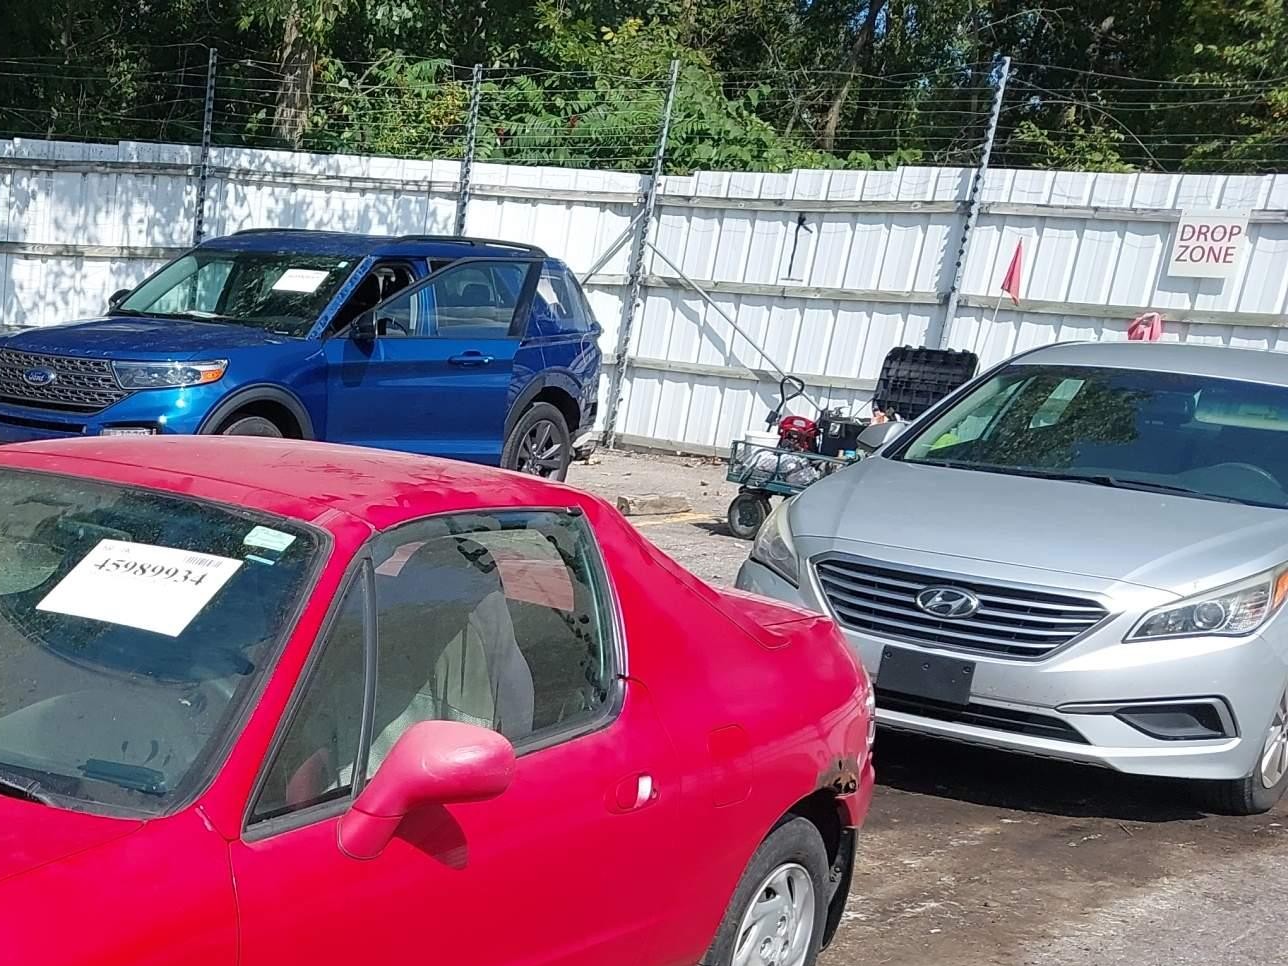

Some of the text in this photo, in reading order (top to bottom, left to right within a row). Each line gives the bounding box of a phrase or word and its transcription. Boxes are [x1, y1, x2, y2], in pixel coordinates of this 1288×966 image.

[1179, 224, 1242, 243] DROP
[1174, 244, 1236, 264] ZONE
[93, 557, 209, 586] 45989934
